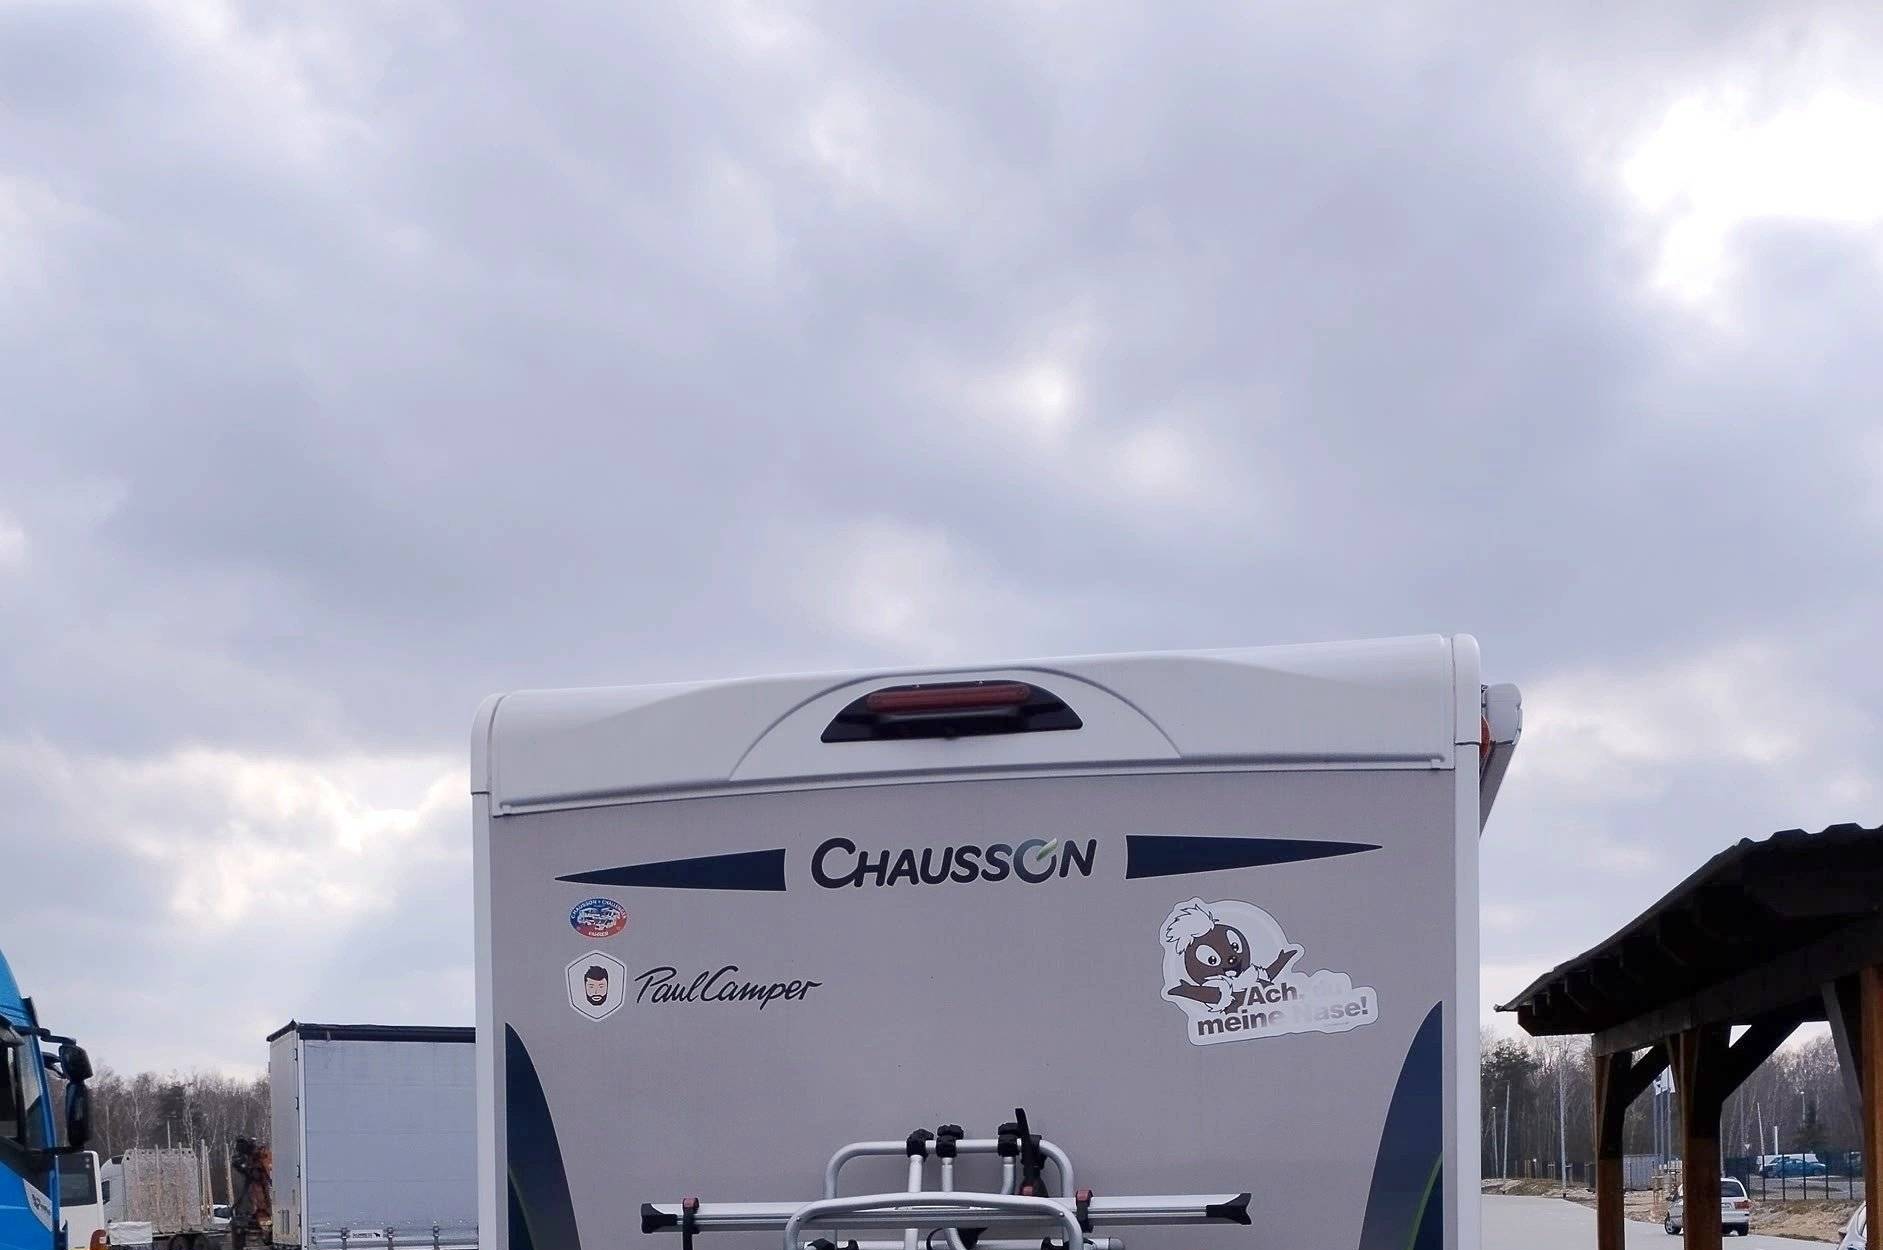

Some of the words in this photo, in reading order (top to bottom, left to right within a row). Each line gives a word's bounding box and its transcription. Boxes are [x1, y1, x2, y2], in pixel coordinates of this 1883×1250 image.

[811, 837, 1098, 889] CHAUSSON
[634, 965, 823, 1011] PaulCamper
[1197, 1009, 1286, 1036] meine
[1292, 996, 1369, 1024] ase!
